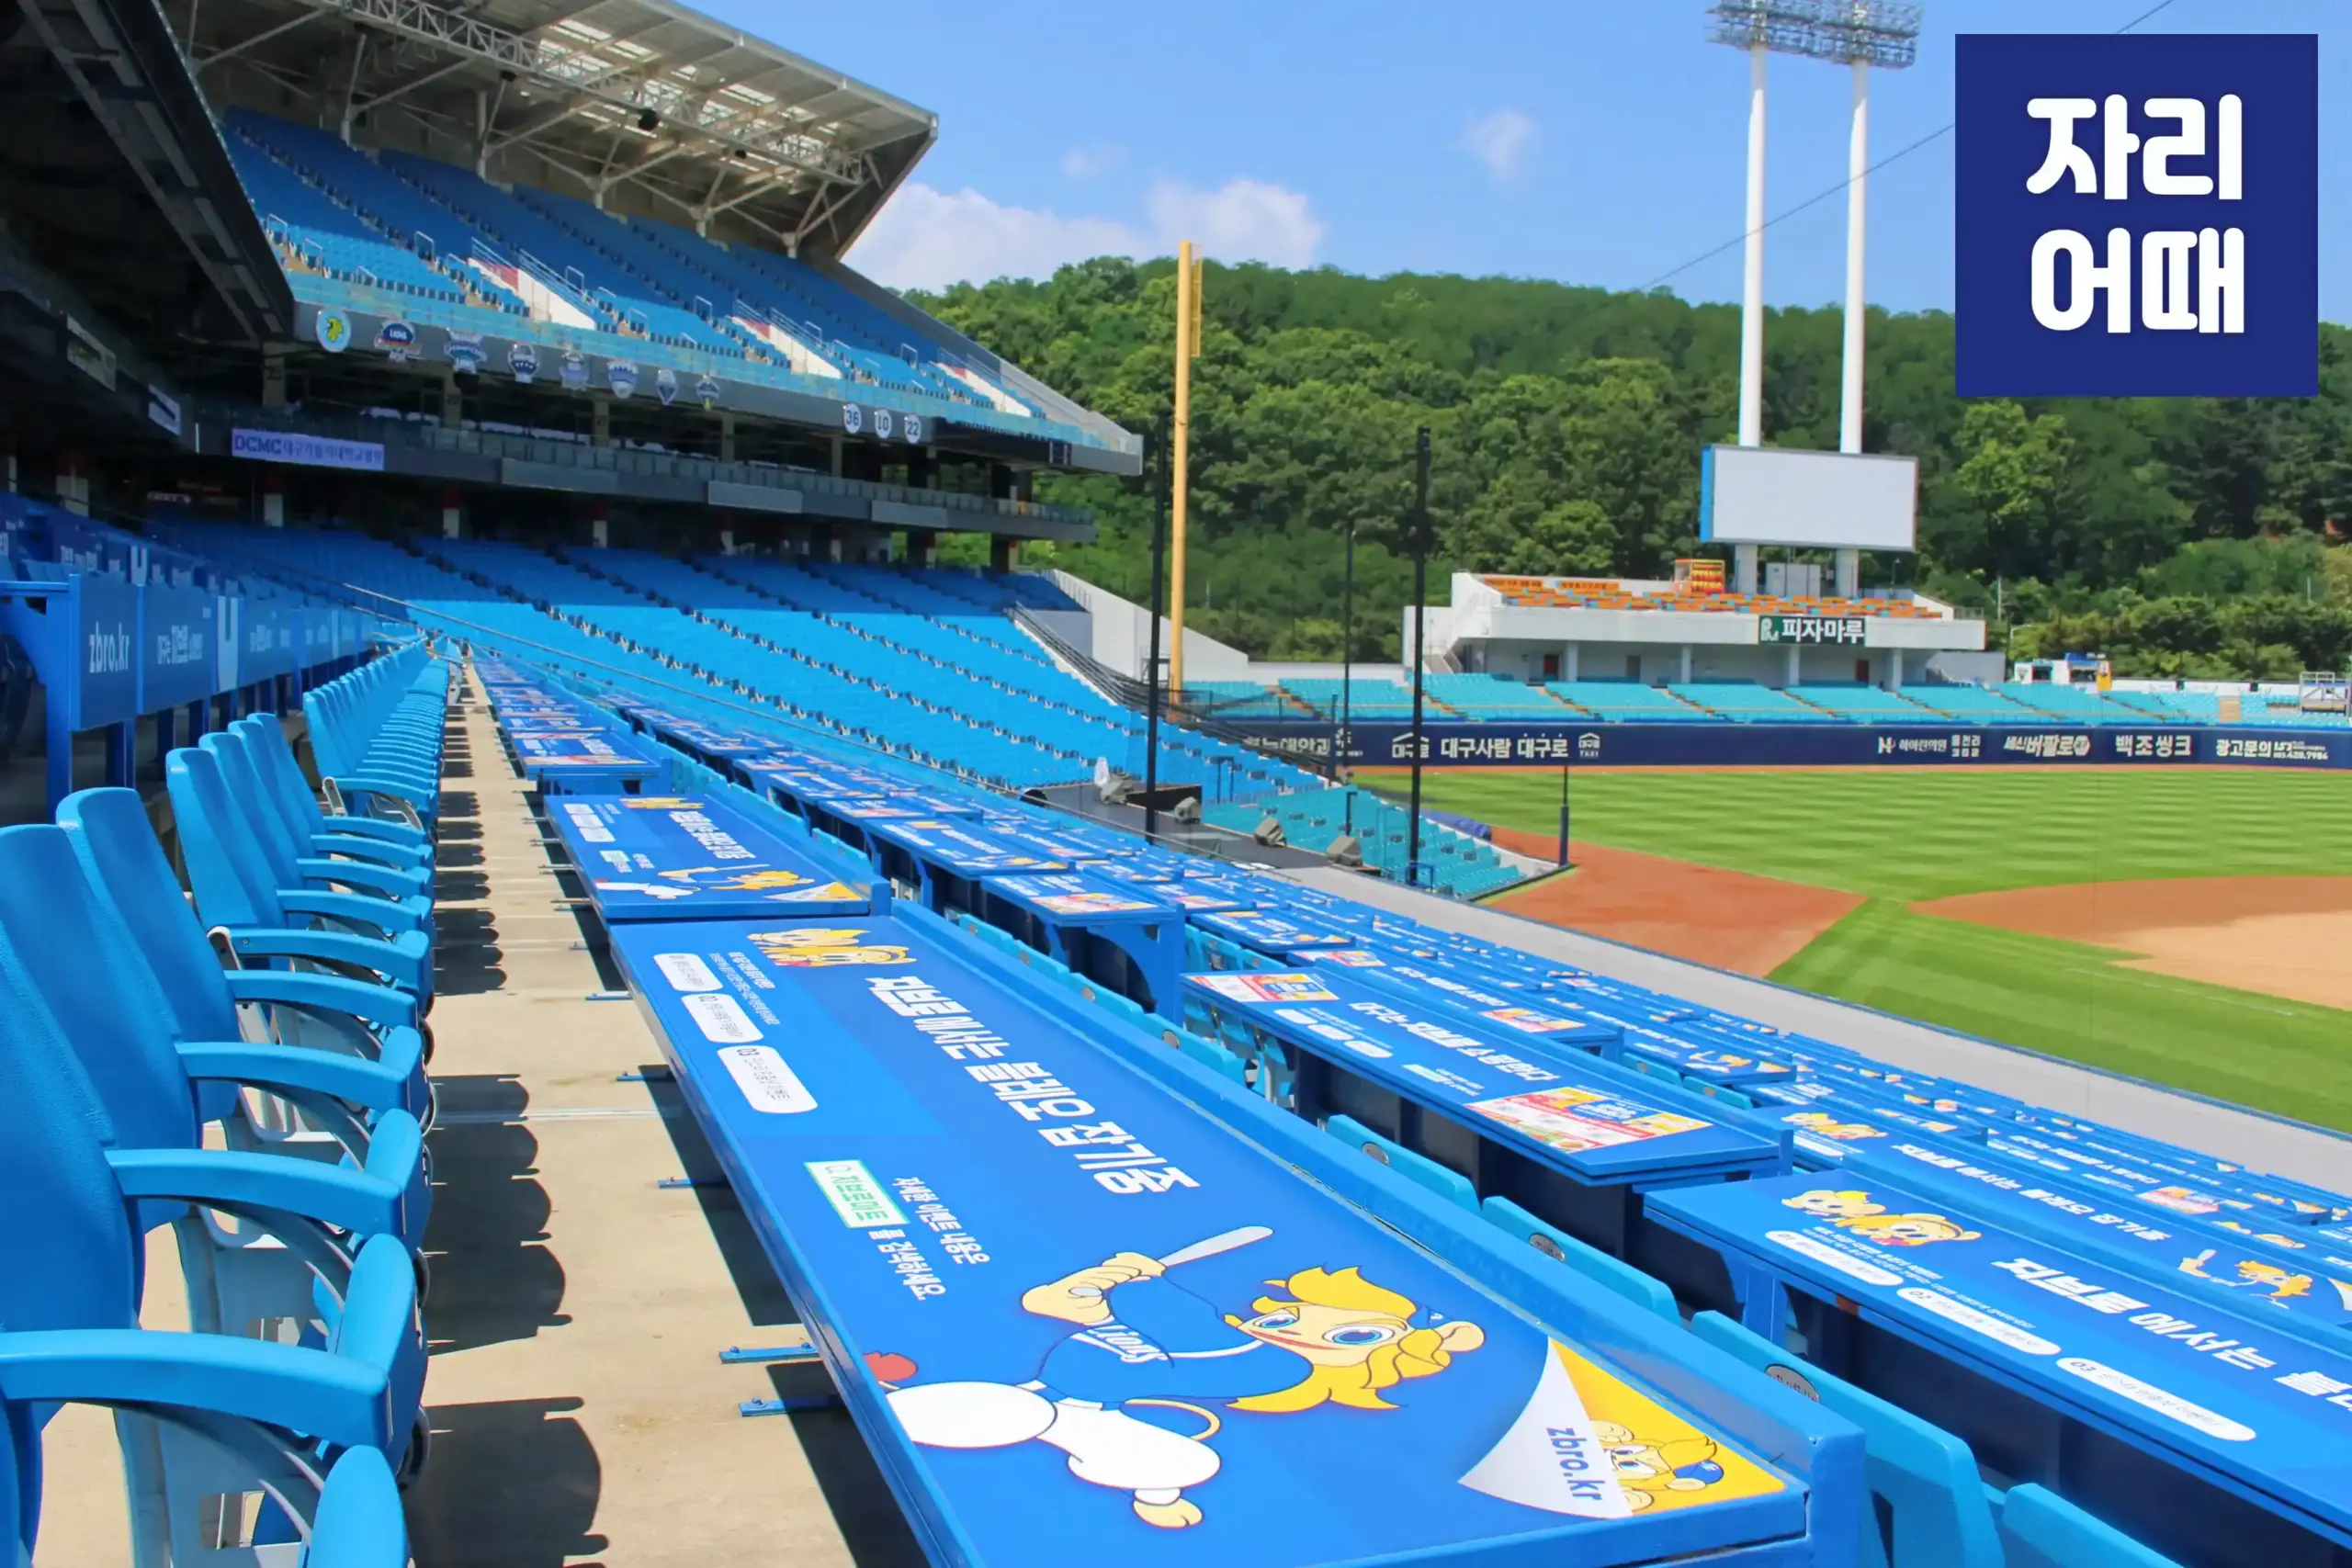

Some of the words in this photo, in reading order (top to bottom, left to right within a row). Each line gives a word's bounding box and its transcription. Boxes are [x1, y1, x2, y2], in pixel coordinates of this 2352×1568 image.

[846, 410, 859, 426] 36
[877, 415, 889, 431] 10
[907, 421, 919, 436] 22
[234, 434, 281, 454] DCMC
[1781, 617, 1864, 644] 피자마루
[89, 621, 130, 673] zbro.kr
[1441, 737, 1512, 759] 대구사람
[1517, 737, 1569, 759] 대구로
[2115, 735, 2192, 757] 백조씽크
[2216, 739, 2271, 759] 광고문의
[964, 1062, 1096, 1122] 블레오
[1037, 1121, 1201, 1194] 잡기중
[892, 1177, 940, 1203] 자세한
[914, 1203, 963, 1233] 이벤트
[940, 1232, 990, 1265] 내용은
[877, 1241, 946, 1301] 검색하세요
[2128, 1312, 2278, 1371] 에서는
[1546, 1427, 1606, 1500] zbro.kr
